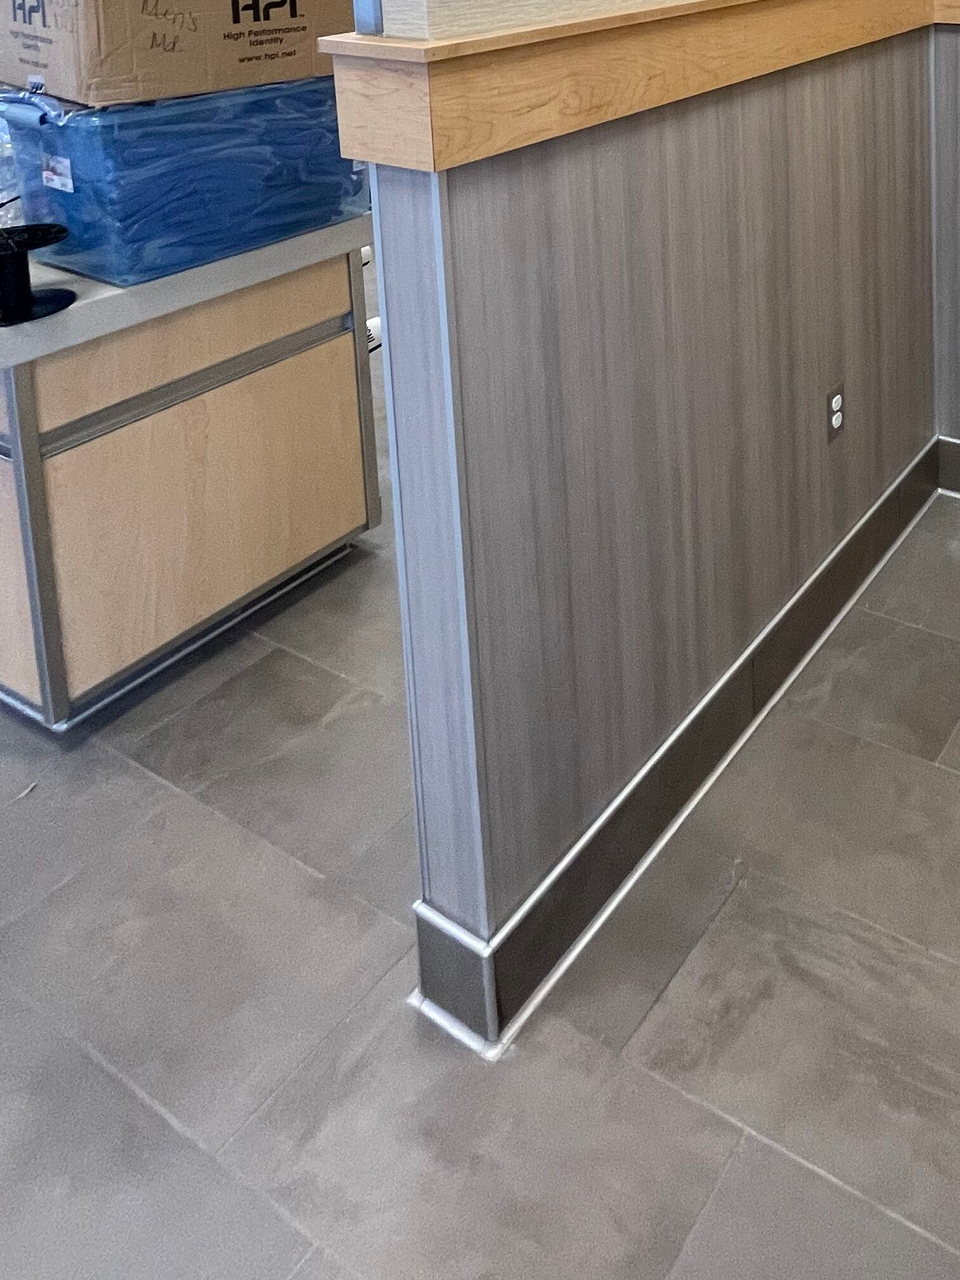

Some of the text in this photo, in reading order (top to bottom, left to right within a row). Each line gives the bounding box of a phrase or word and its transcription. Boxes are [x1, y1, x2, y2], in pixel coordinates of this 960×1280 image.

[223, 24, 308, 42] High Performance
[249, 36, 285, 47] Identity
[238, 49, 297, 64] www.hpi.net
